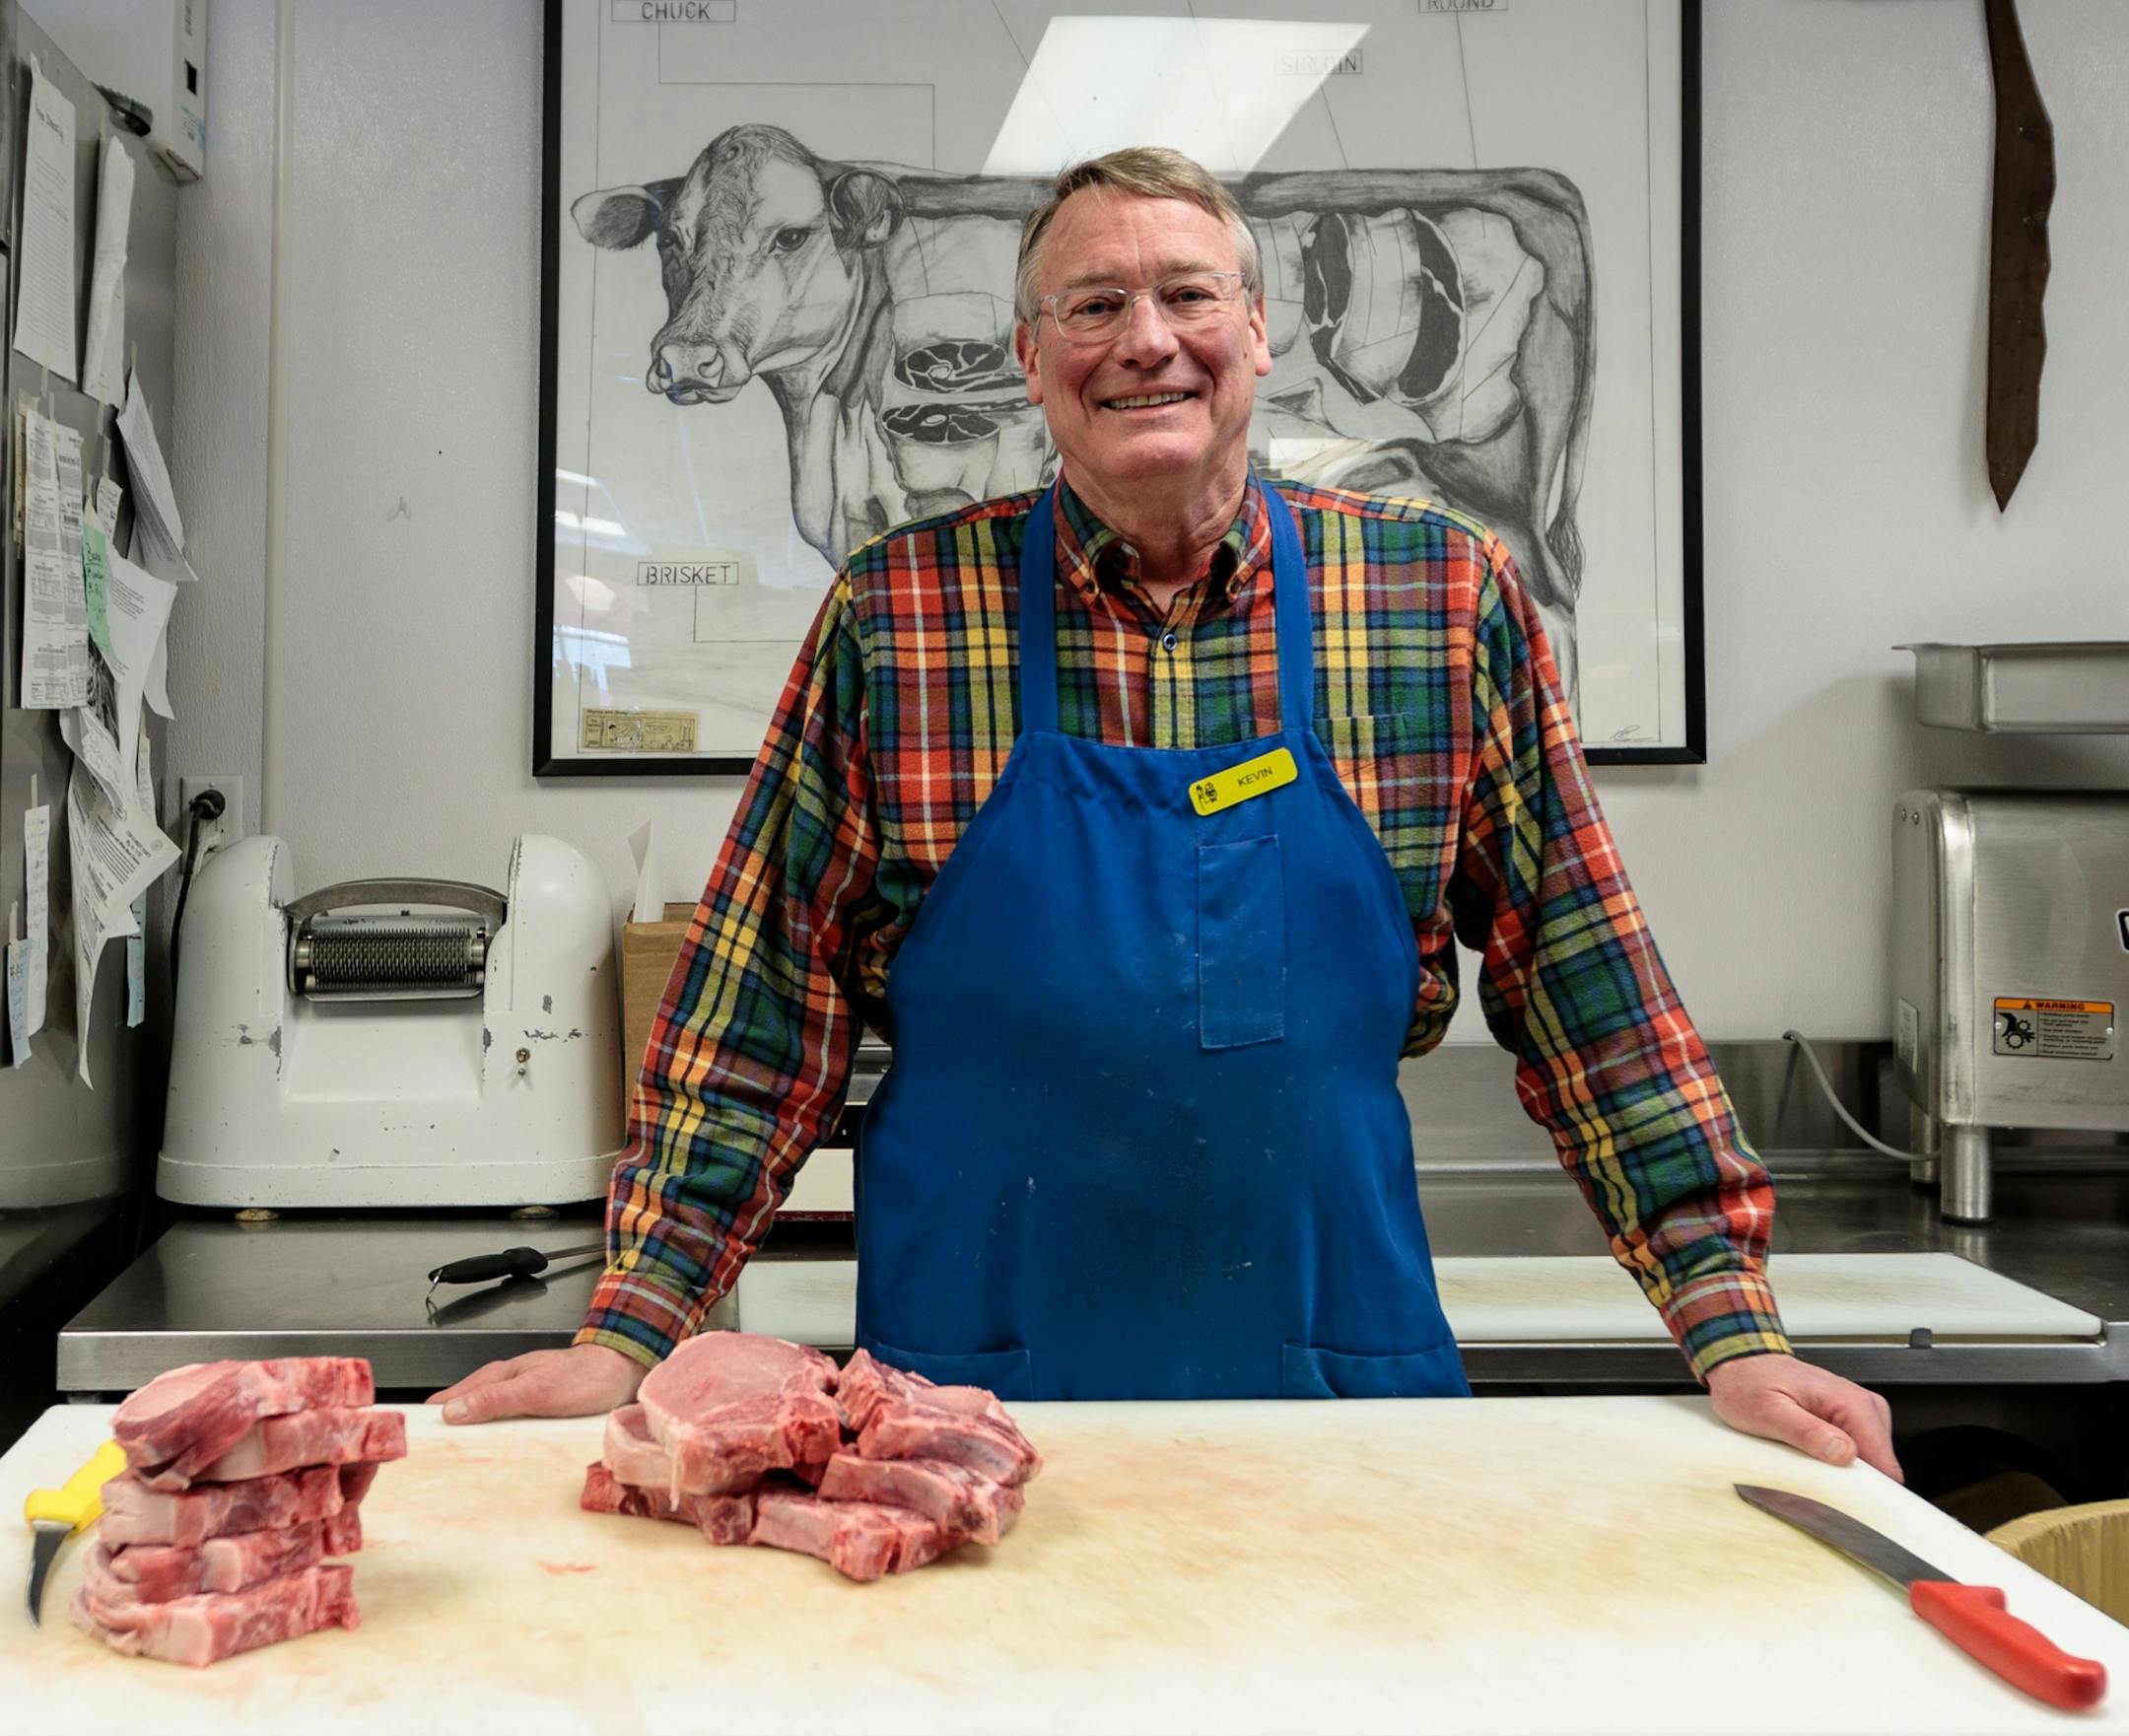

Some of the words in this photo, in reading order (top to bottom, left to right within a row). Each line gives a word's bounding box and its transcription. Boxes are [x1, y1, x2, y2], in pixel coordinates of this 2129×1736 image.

[641, 2, 711, 20] CHUCK
[647, 565, 731, 585] BRISKET
[1237, 766, 1273, 788] KEVIN
[2035, 1002, 2086, 1010] WARNING
